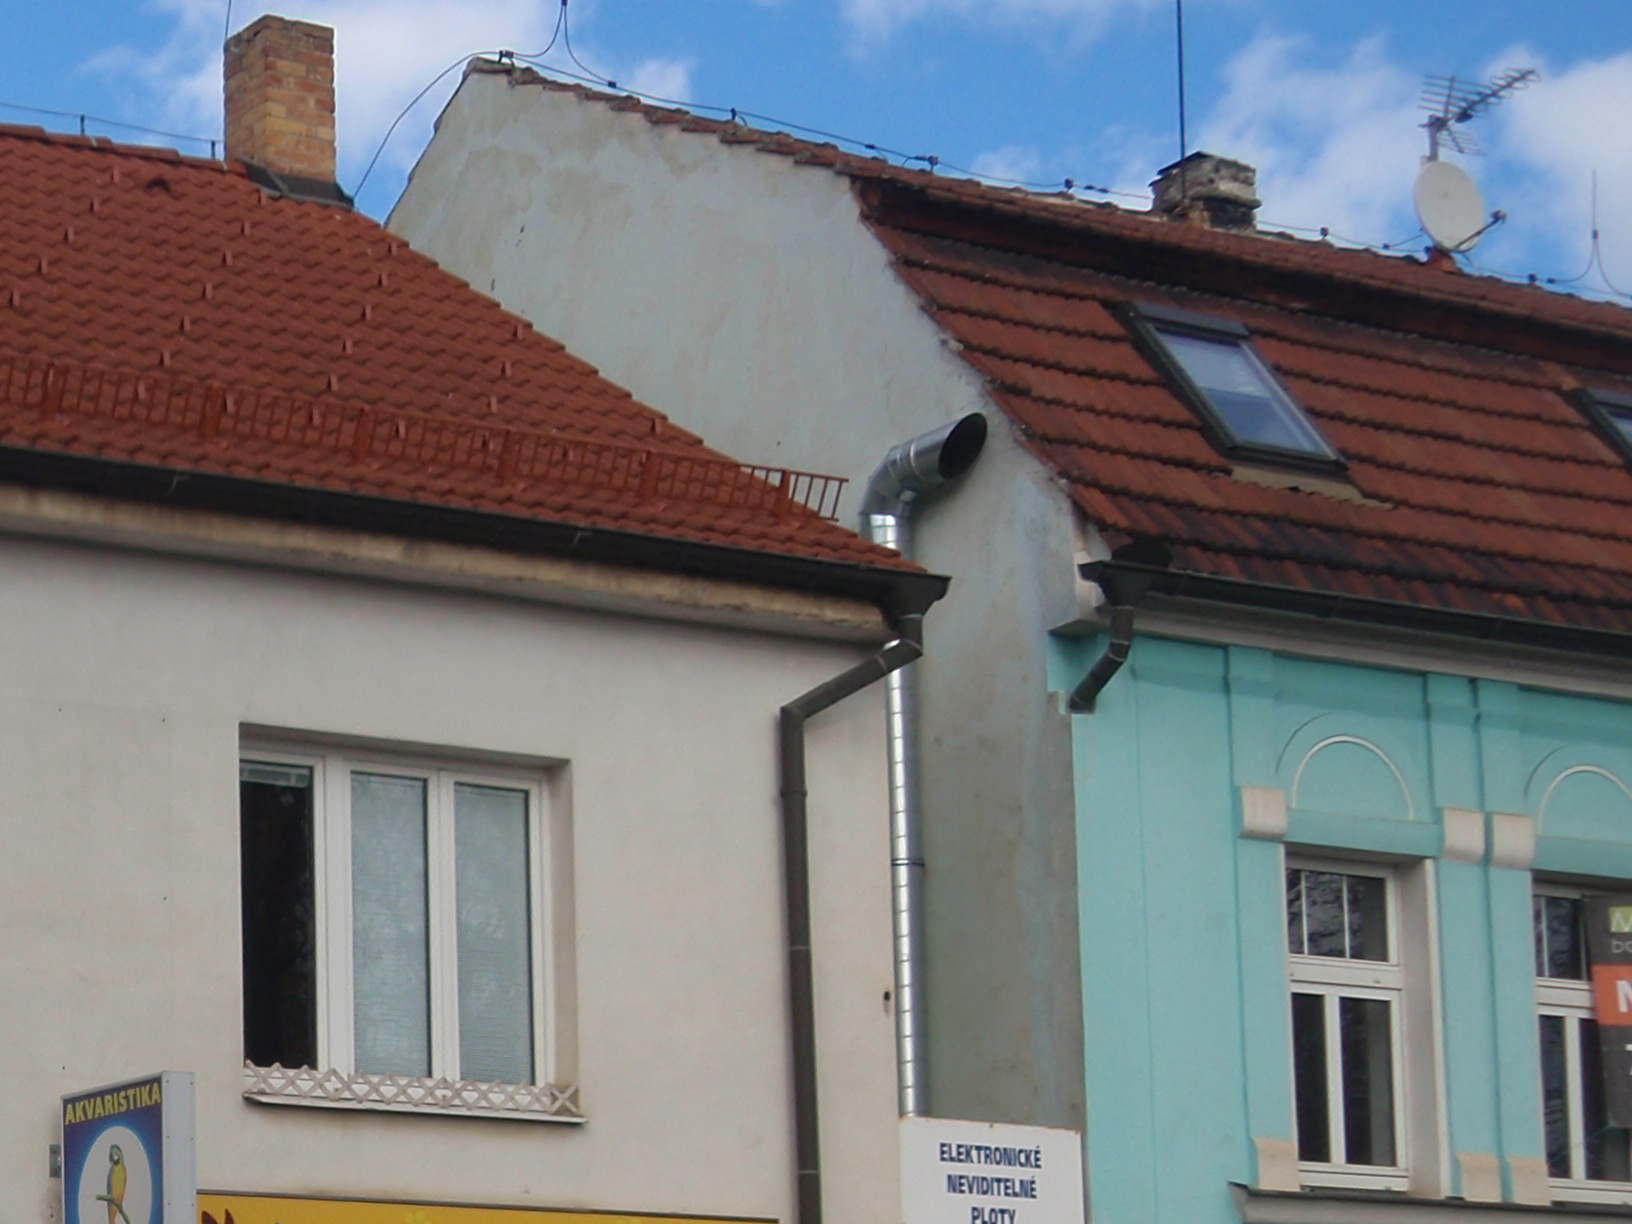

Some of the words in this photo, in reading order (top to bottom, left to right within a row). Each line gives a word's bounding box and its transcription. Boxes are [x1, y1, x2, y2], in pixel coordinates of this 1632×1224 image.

[65, 1082, 161, 1125] AKVARISTIKA
[939, 1142, 1042, 1169] ELEKTRONICKÉ
[947, 1174, 1037, 1199] NEVIDITELNÉ
